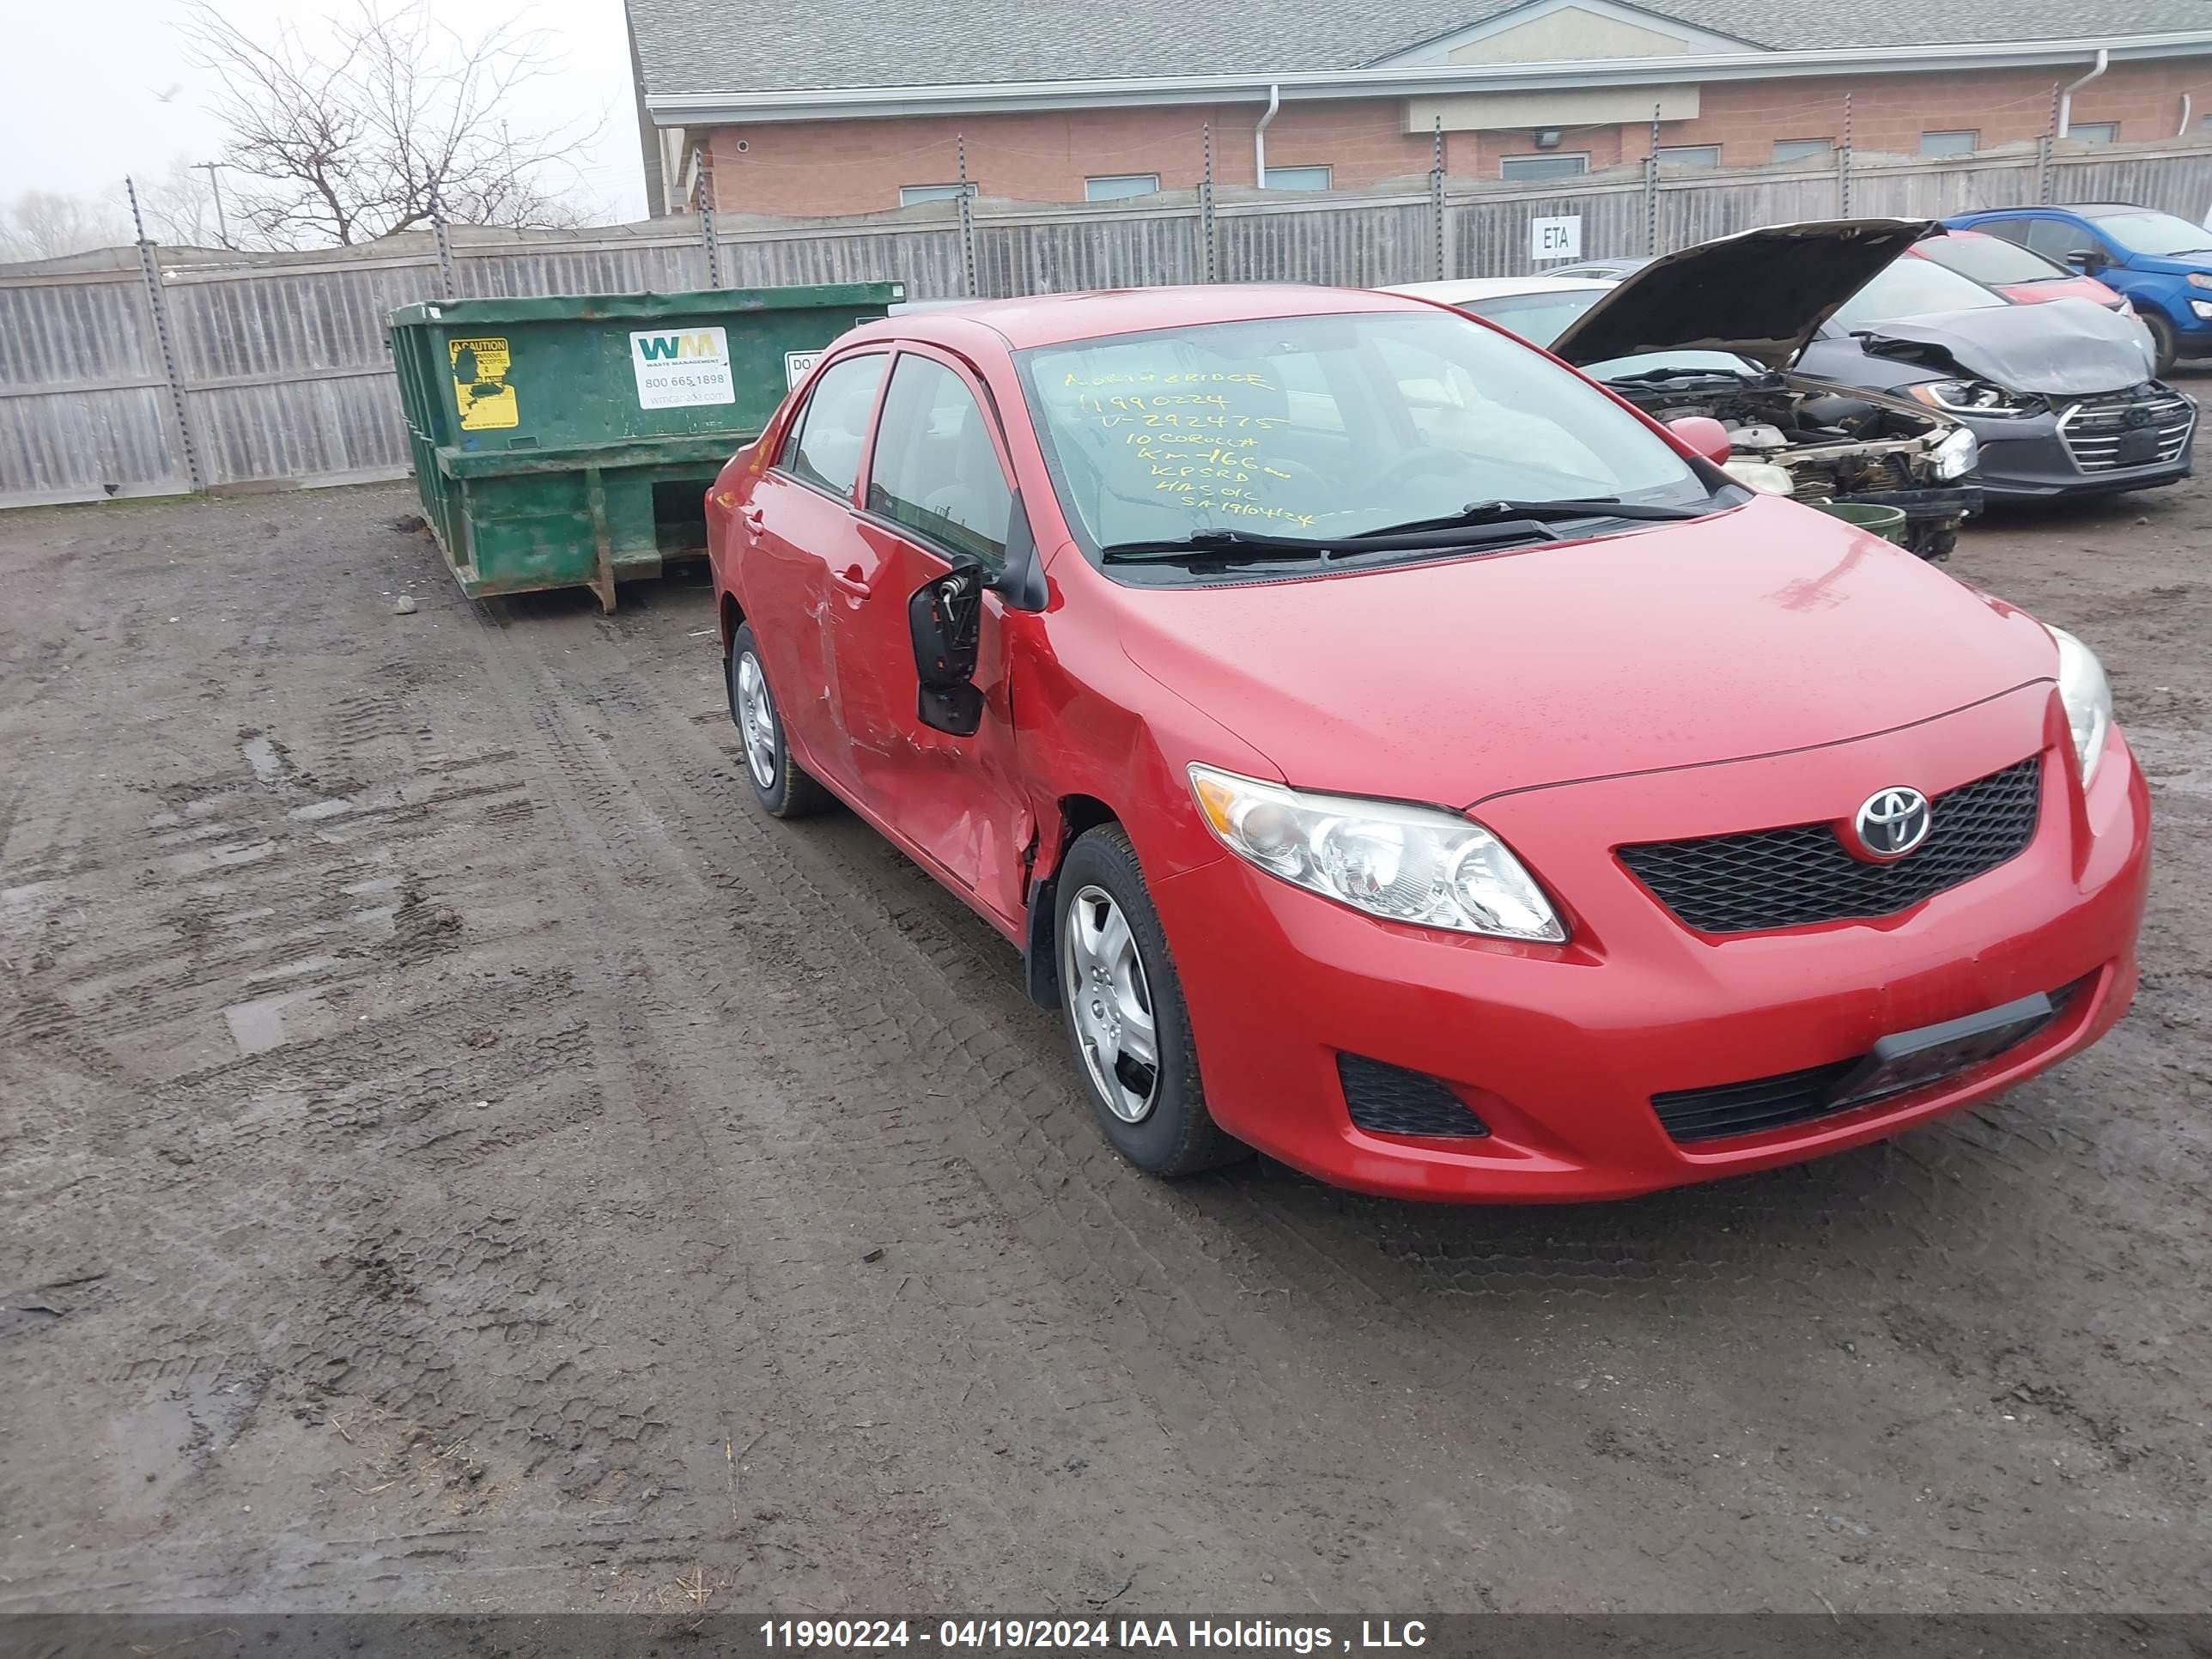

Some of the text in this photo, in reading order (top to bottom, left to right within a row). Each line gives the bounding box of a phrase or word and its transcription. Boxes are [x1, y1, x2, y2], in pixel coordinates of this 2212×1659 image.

[1544, 227, 1569, 249] ETA
[638, 334, 716, 361] WM
[793, 359, 811, 370] DO
[646, 374, 725, 388] 800 665 1898
[1126, 433, 1152, 445] 10
